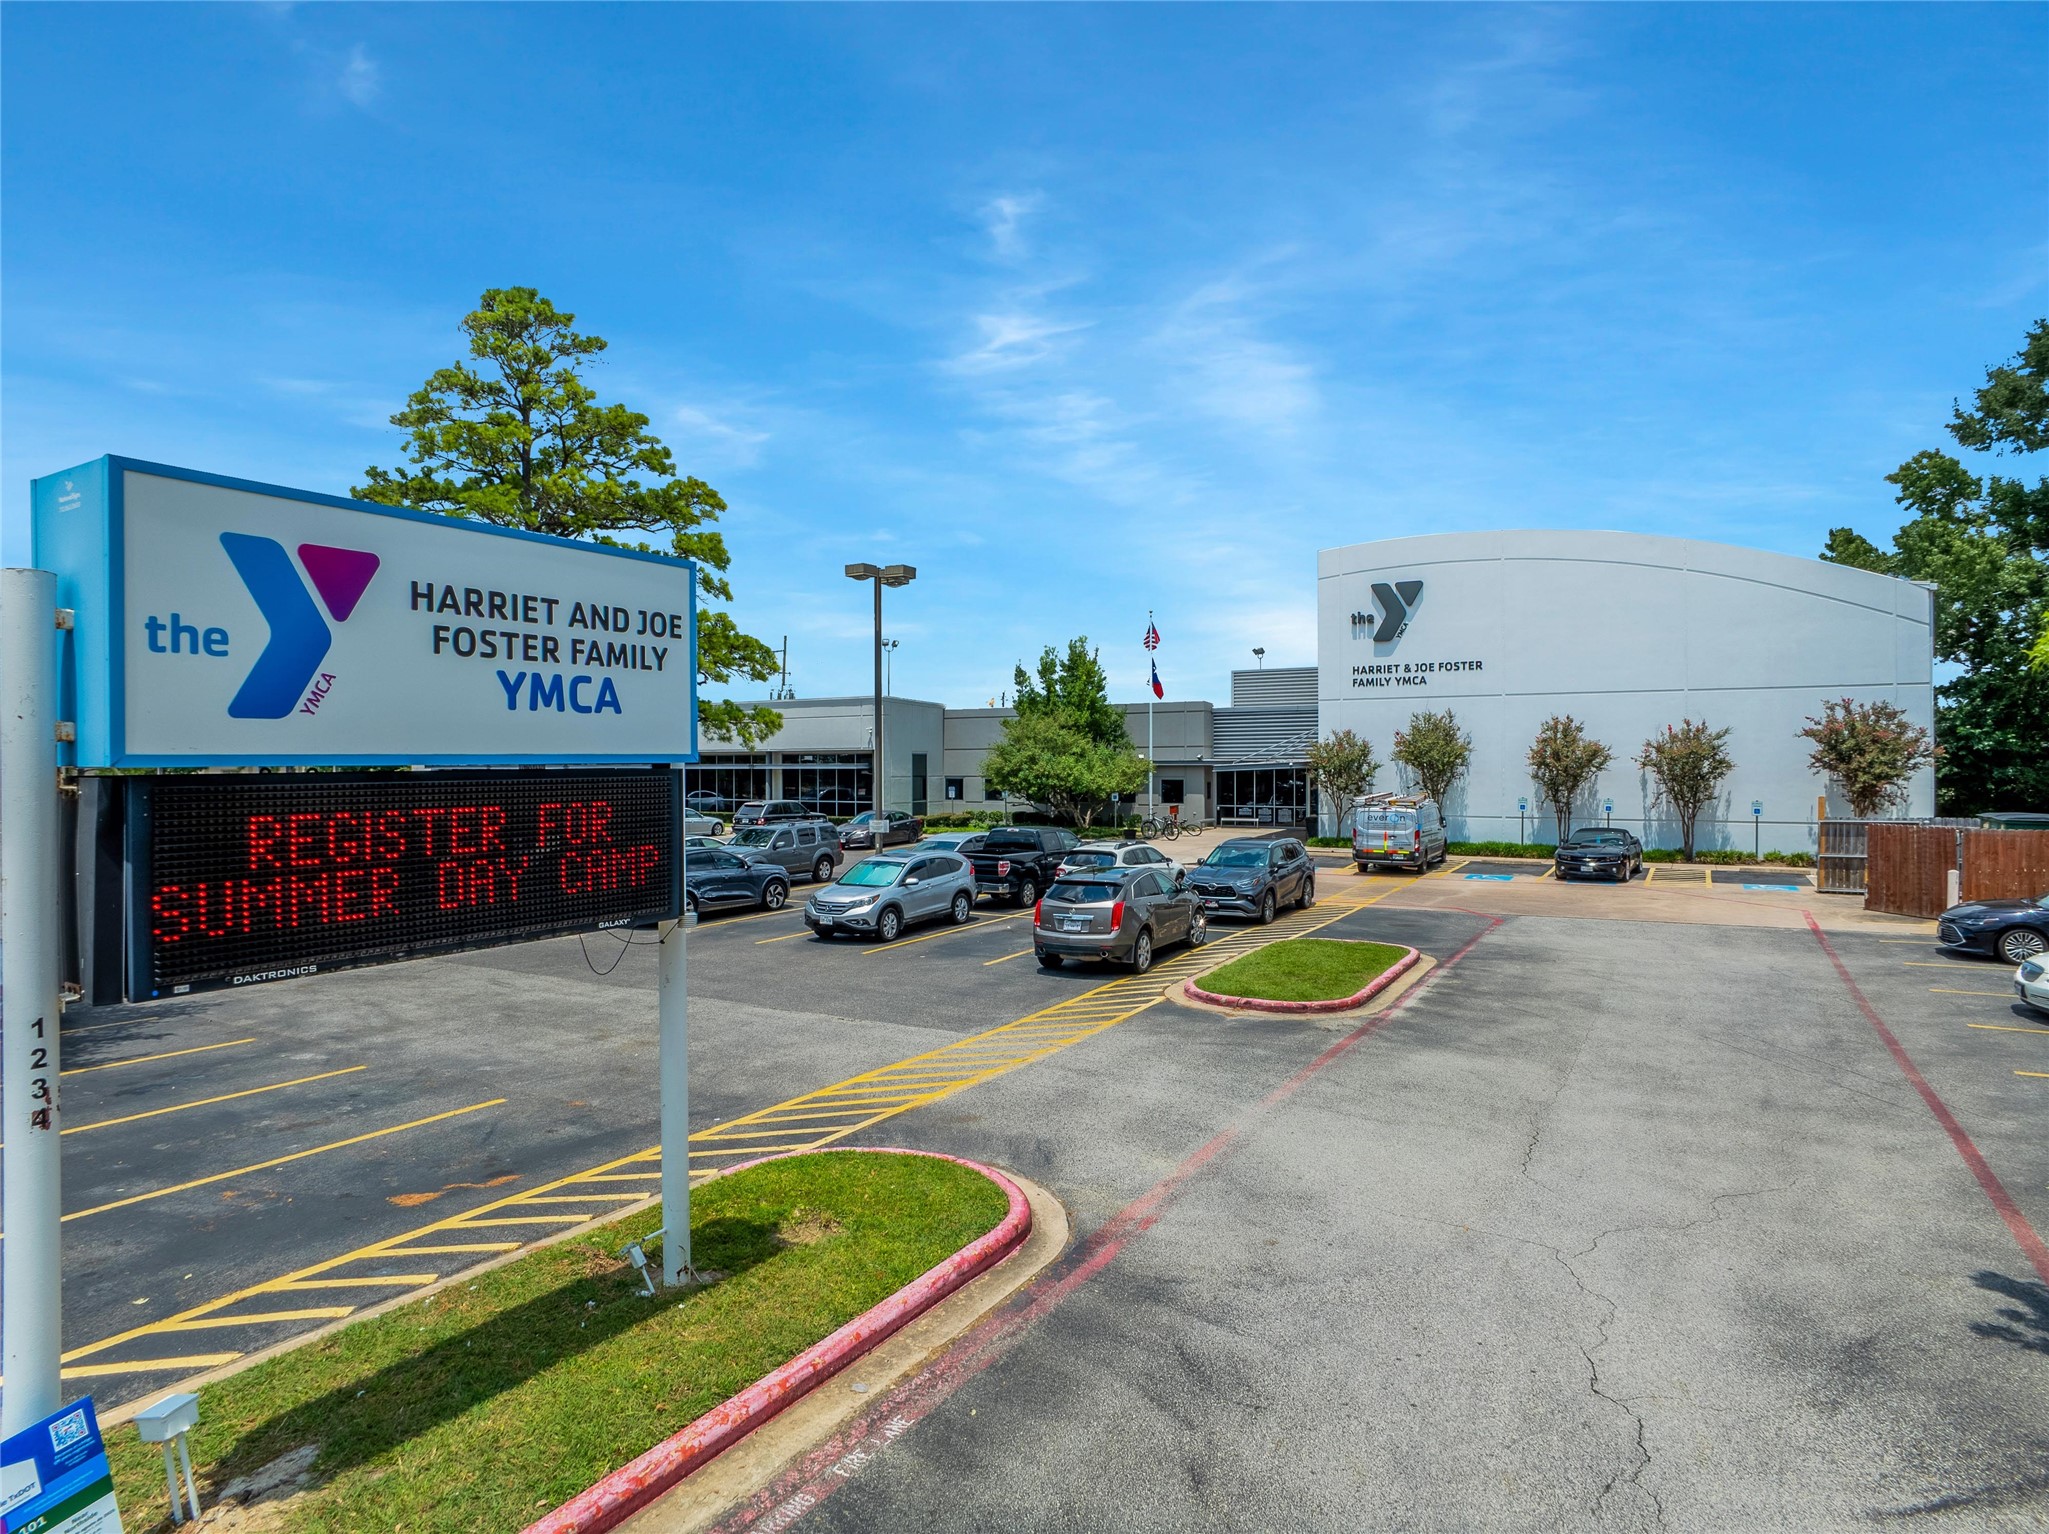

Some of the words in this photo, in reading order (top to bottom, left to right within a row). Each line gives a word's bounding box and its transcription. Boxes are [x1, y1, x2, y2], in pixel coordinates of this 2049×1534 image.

[410, 580, 560, 626] HARRIET
[568, 601, 630, 632] AND
[636, 609, 683, 639] JOE
[1350, 611, 1375, 625] the
[144, 612, 229, 657] the
[432, 624, 561, 664] FOSTER
[570, 638, 668, 672] FAMILY
[1395, 621, 1409, 639] YMCA
[1352, 664, 1400, 676] HARRIET
[1403, 663, 1412, 673] &
[1414, 662, 1435, 672] JOE
[1438, 660, 1483, 672] FOSTER
[1352, 677, 1392, 688] FAMILY
[1394, 675, 1427, 686] YMCA
[299, 672, 337, 716] YMCA
[496, 669, 622, 715] YMCA
[249, 804, 506, 870] REGISTER
[539, 800, 613, 847] FOR
[152, 867, 400, 942] SUMMER
[438, 854, 529, 910] DAY
[560, 844, 660, 894] CAMP
[232, 964, 318, 985] DAKTRONICS
[832, 1448, 875, 1477] FIRE
[7, 1481, 37, 1502] TxDOT
